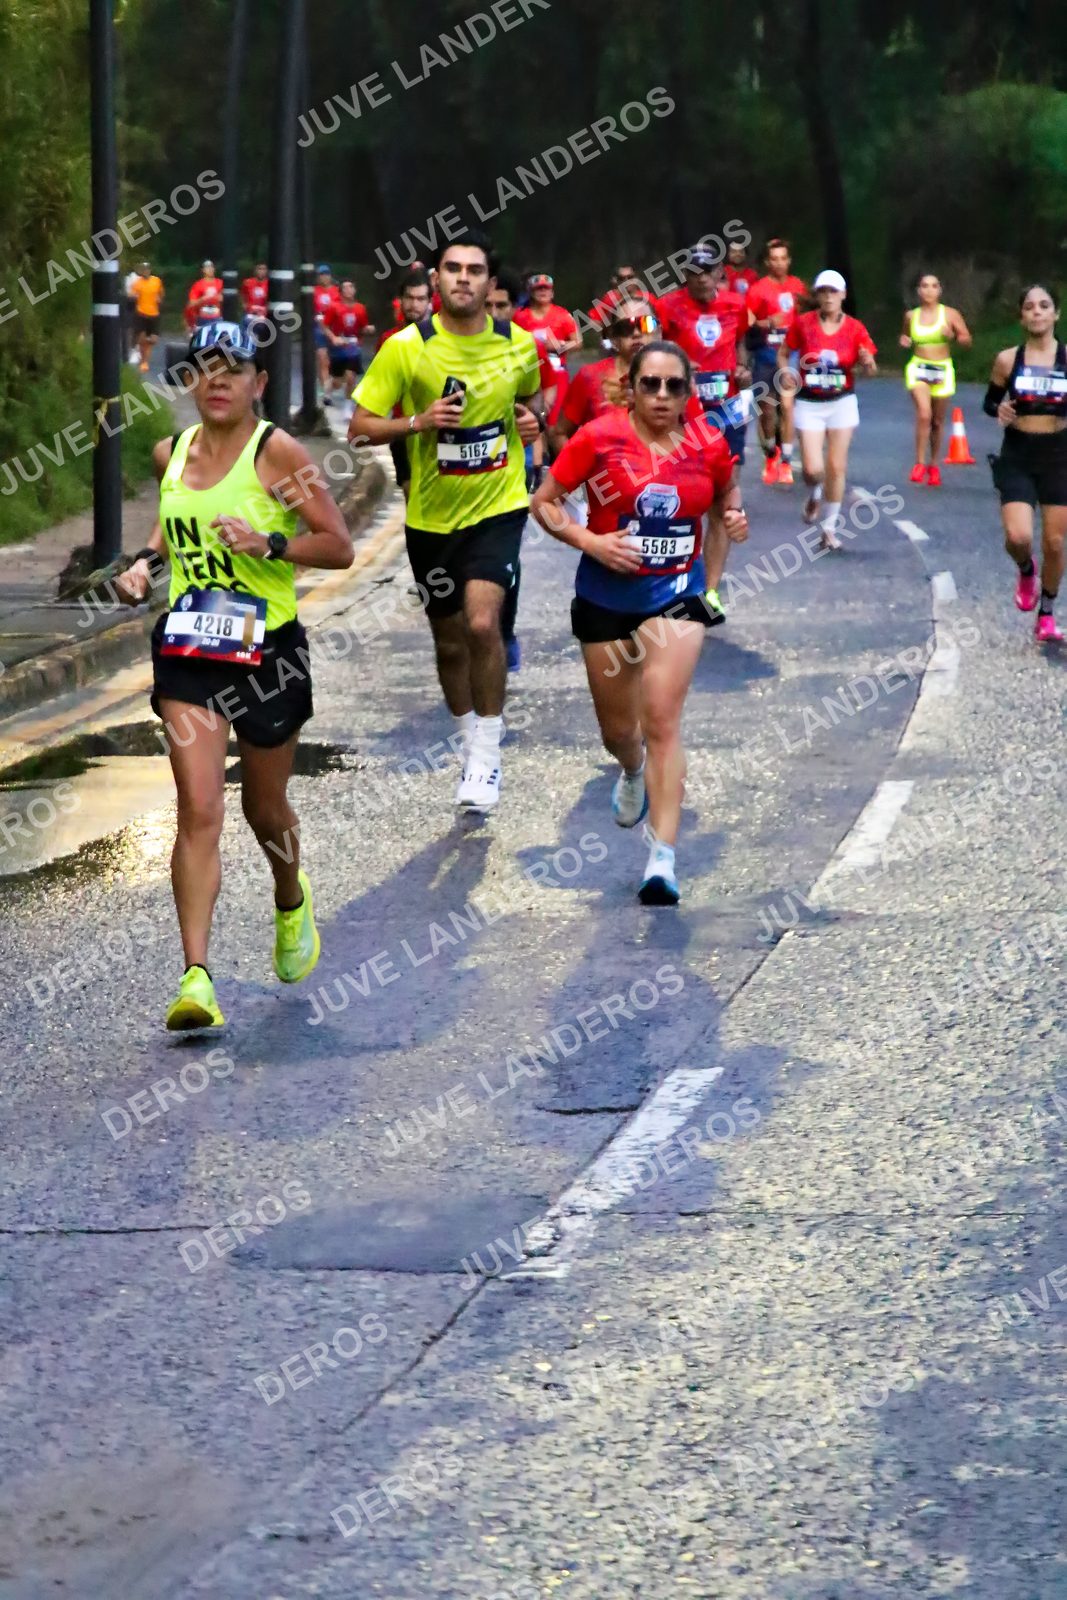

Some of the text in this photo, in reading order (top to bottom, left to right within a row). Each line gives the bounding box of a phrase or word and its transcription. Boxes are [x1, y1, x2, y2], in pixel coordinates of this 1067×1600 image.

[460, 442, 488, 459] 5162
[166, 516, 202, 549] IN
[641, 538, 677, 555] 5583
[193, 614, 234, 637] 4218
